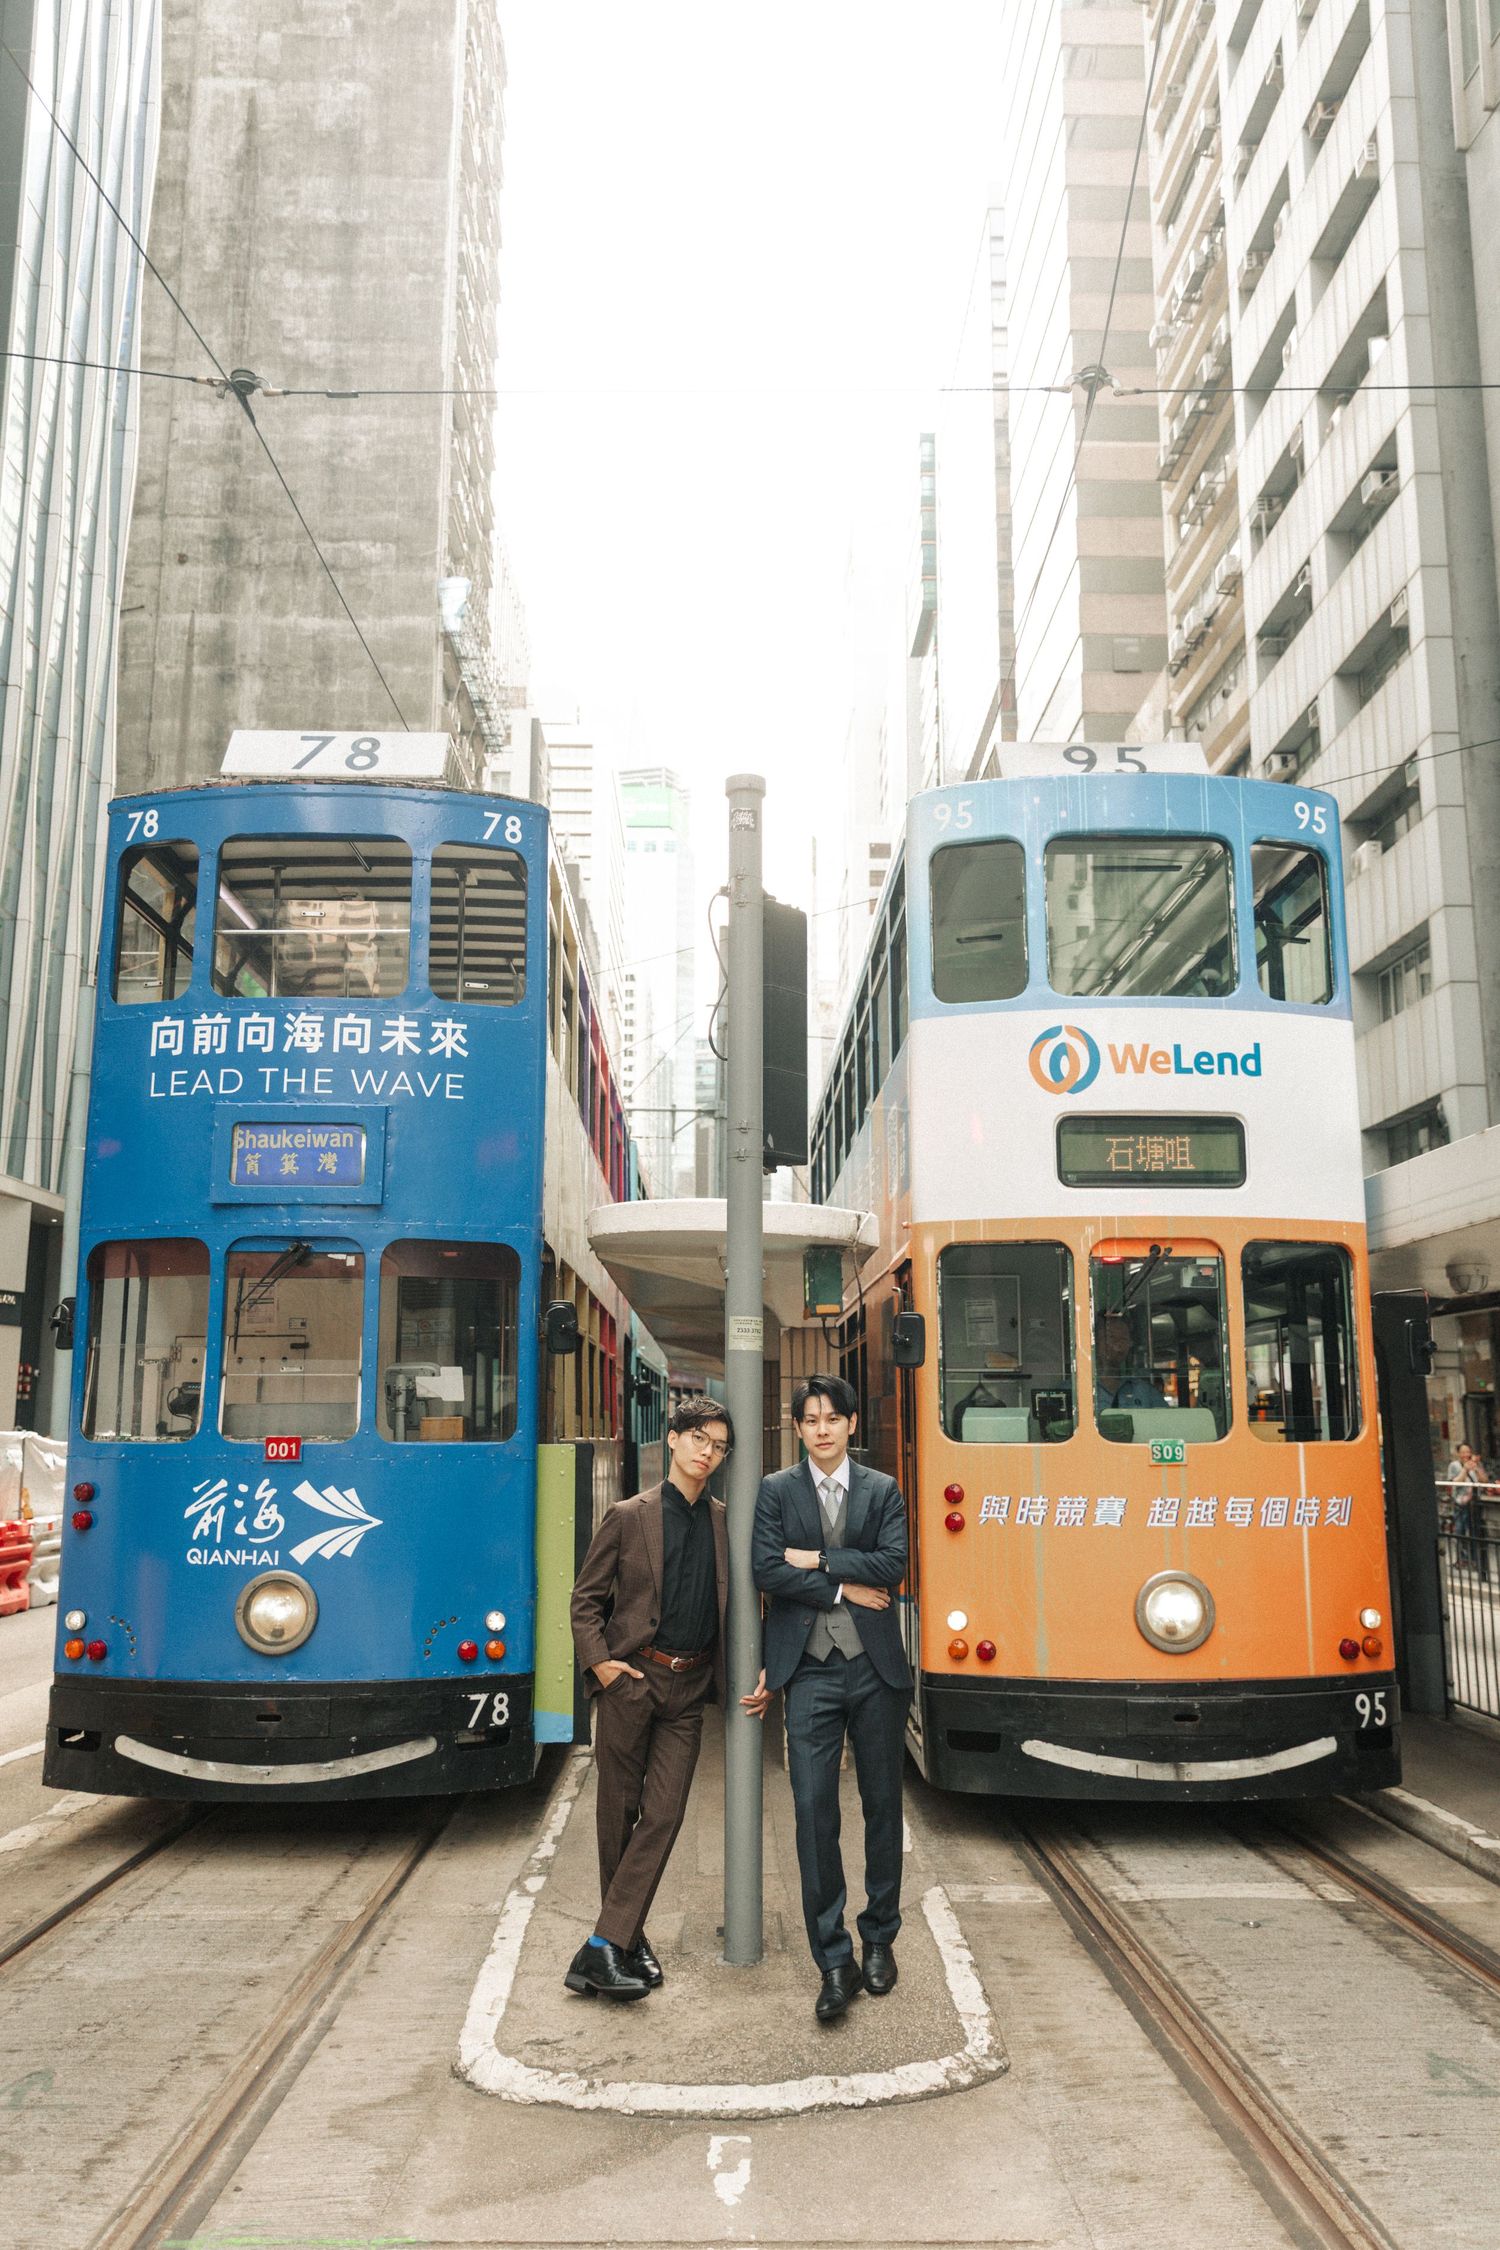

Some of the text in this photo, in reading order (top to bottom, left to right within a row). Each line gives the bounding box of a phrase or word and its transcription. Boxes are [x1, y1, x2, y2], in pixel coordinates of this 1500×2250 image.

[291, 735, 381, 771] 78
[1063, 745, 1147, 773] 95
[126, 809, 159, 842] 78
[482, 811, 523, 844] 78
[932, 800, 974, 831] 95
[1294, 802, 1327, 834] 95
[150, 1012, 469, 1058] 向前向海向未來
[1107, 1042, 1262, 1077] WeLend
[150, 1068, 464, 1099] LEAD THE WAVE
[236, 1128, 354, 1150] Shaukeiwan
[1106, 1136, 1196, 1171] 石塘咀
[267, 1443, 297, 1457] 001
[1152, 1445, 1183, 1460] S09
[184, 1478, 285, 1543] 前海
[979, 1495, 1353, 1529] 與時競賽 超越每個時刻
[186, 1548, 279, 1566] QIANHAI
[466, 1692, 509, 1728] 78
[1354, 1691, 1387, 1728] 95
